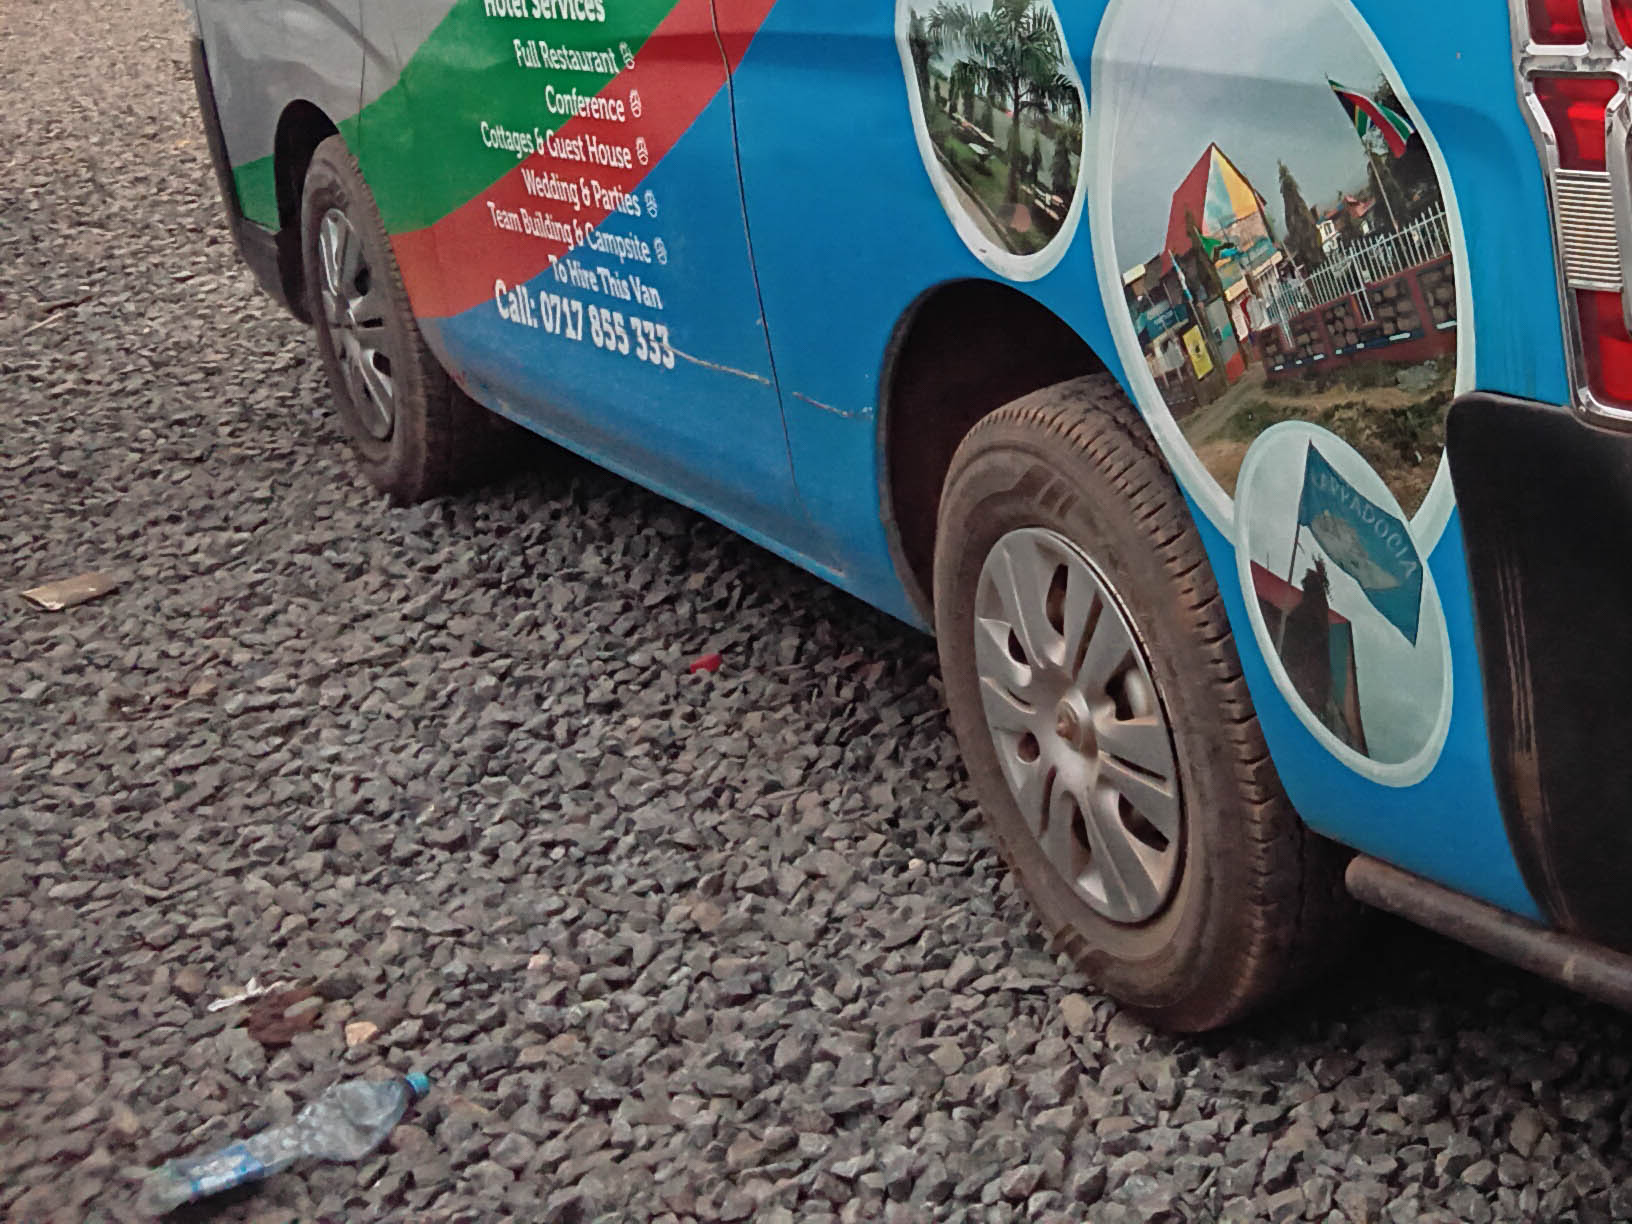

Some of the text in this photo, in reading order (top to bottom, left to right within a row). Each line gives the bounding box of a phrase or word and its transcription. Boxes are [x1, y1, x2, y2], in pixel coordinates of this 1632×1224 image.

[513, 38, 618, 75] Full Restaurant
[545, 85, 625, 122] Conference
[480, 121, 632, 169] Cottages & Guest House
[521, 168, 641, 217] Wedding & Parties
[487, 201, 651, 265] Team Building & Campsite
[547, 254, 664, 310] To Hire This Van
[494, 279, 676, 370] Call: 0717 855 333
